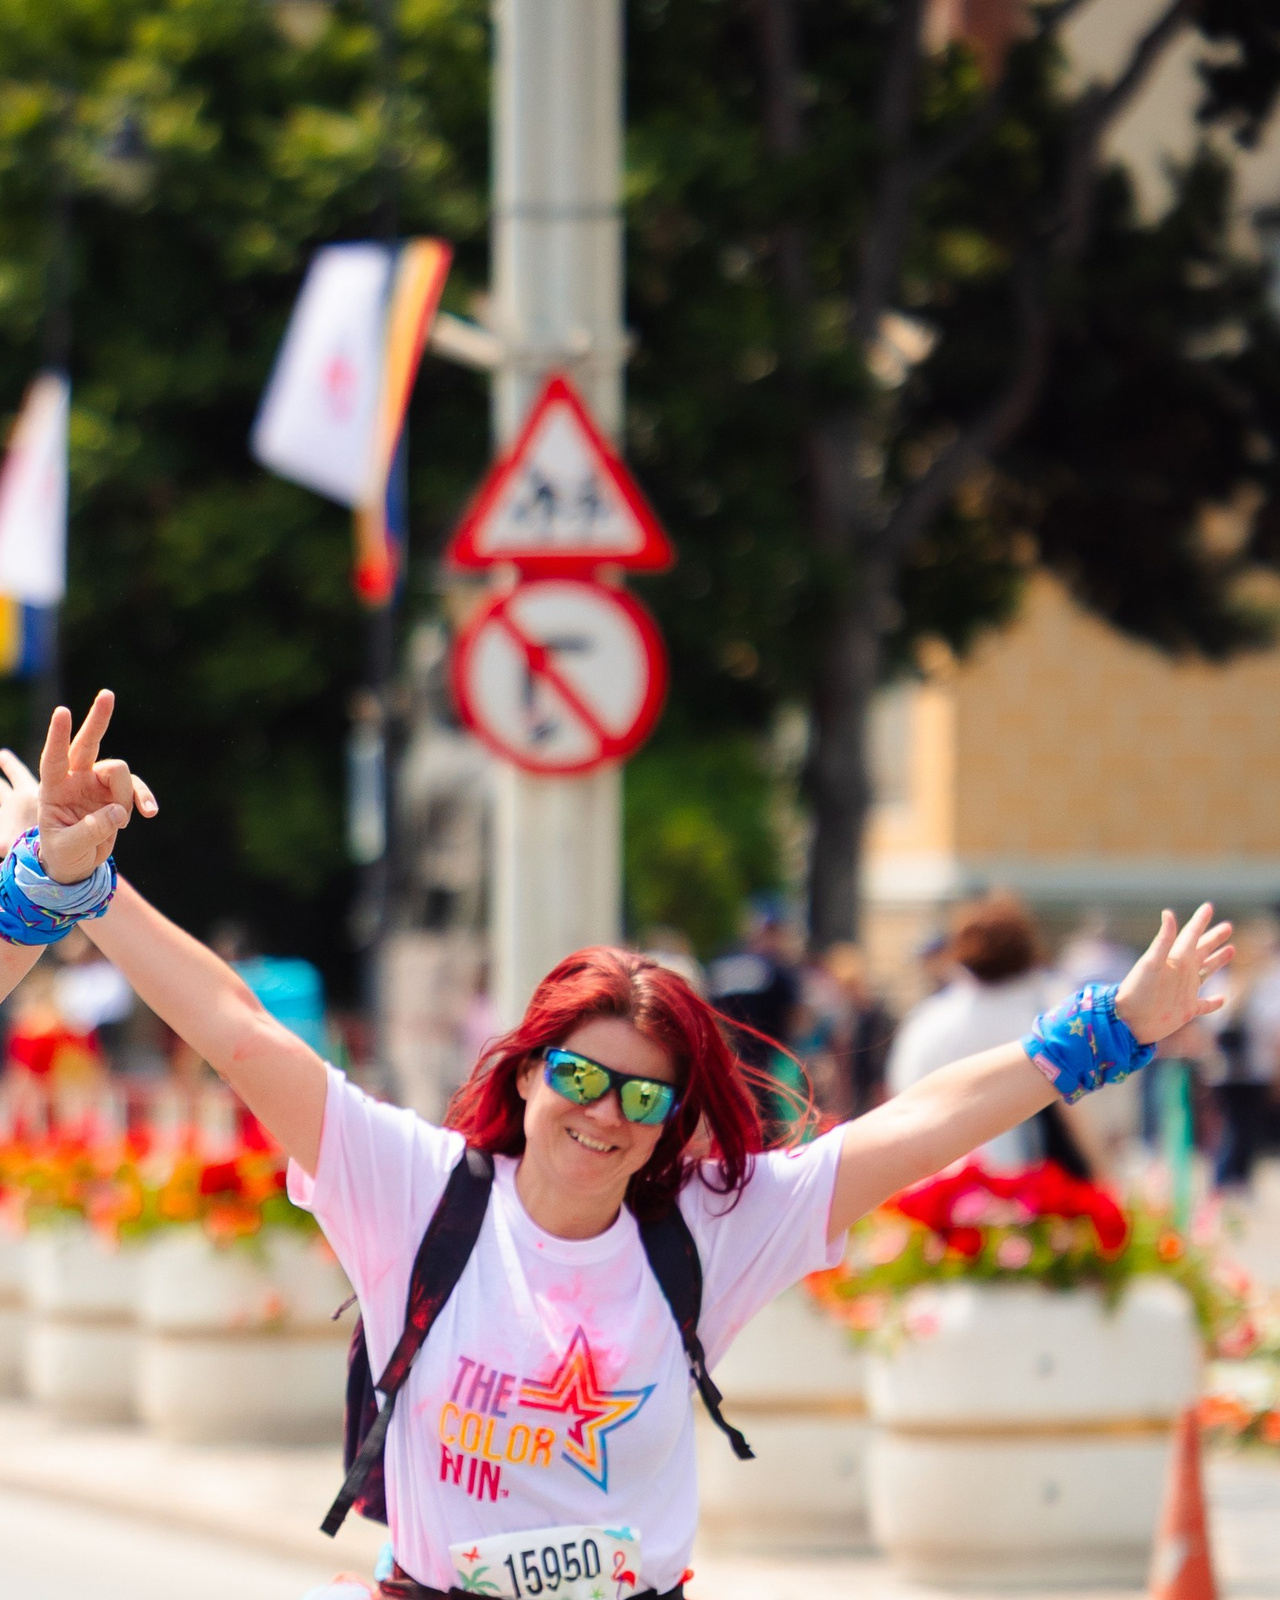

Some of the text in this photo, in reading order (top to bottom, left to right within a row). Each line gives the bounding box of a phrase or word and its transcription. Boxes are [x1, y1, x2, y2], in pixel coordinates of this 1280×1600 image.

[449, 1355, 517, 1418] THE
[438, 1402, 556, 1469] COLOR
[503, 1538, 601, 1600] 15950
